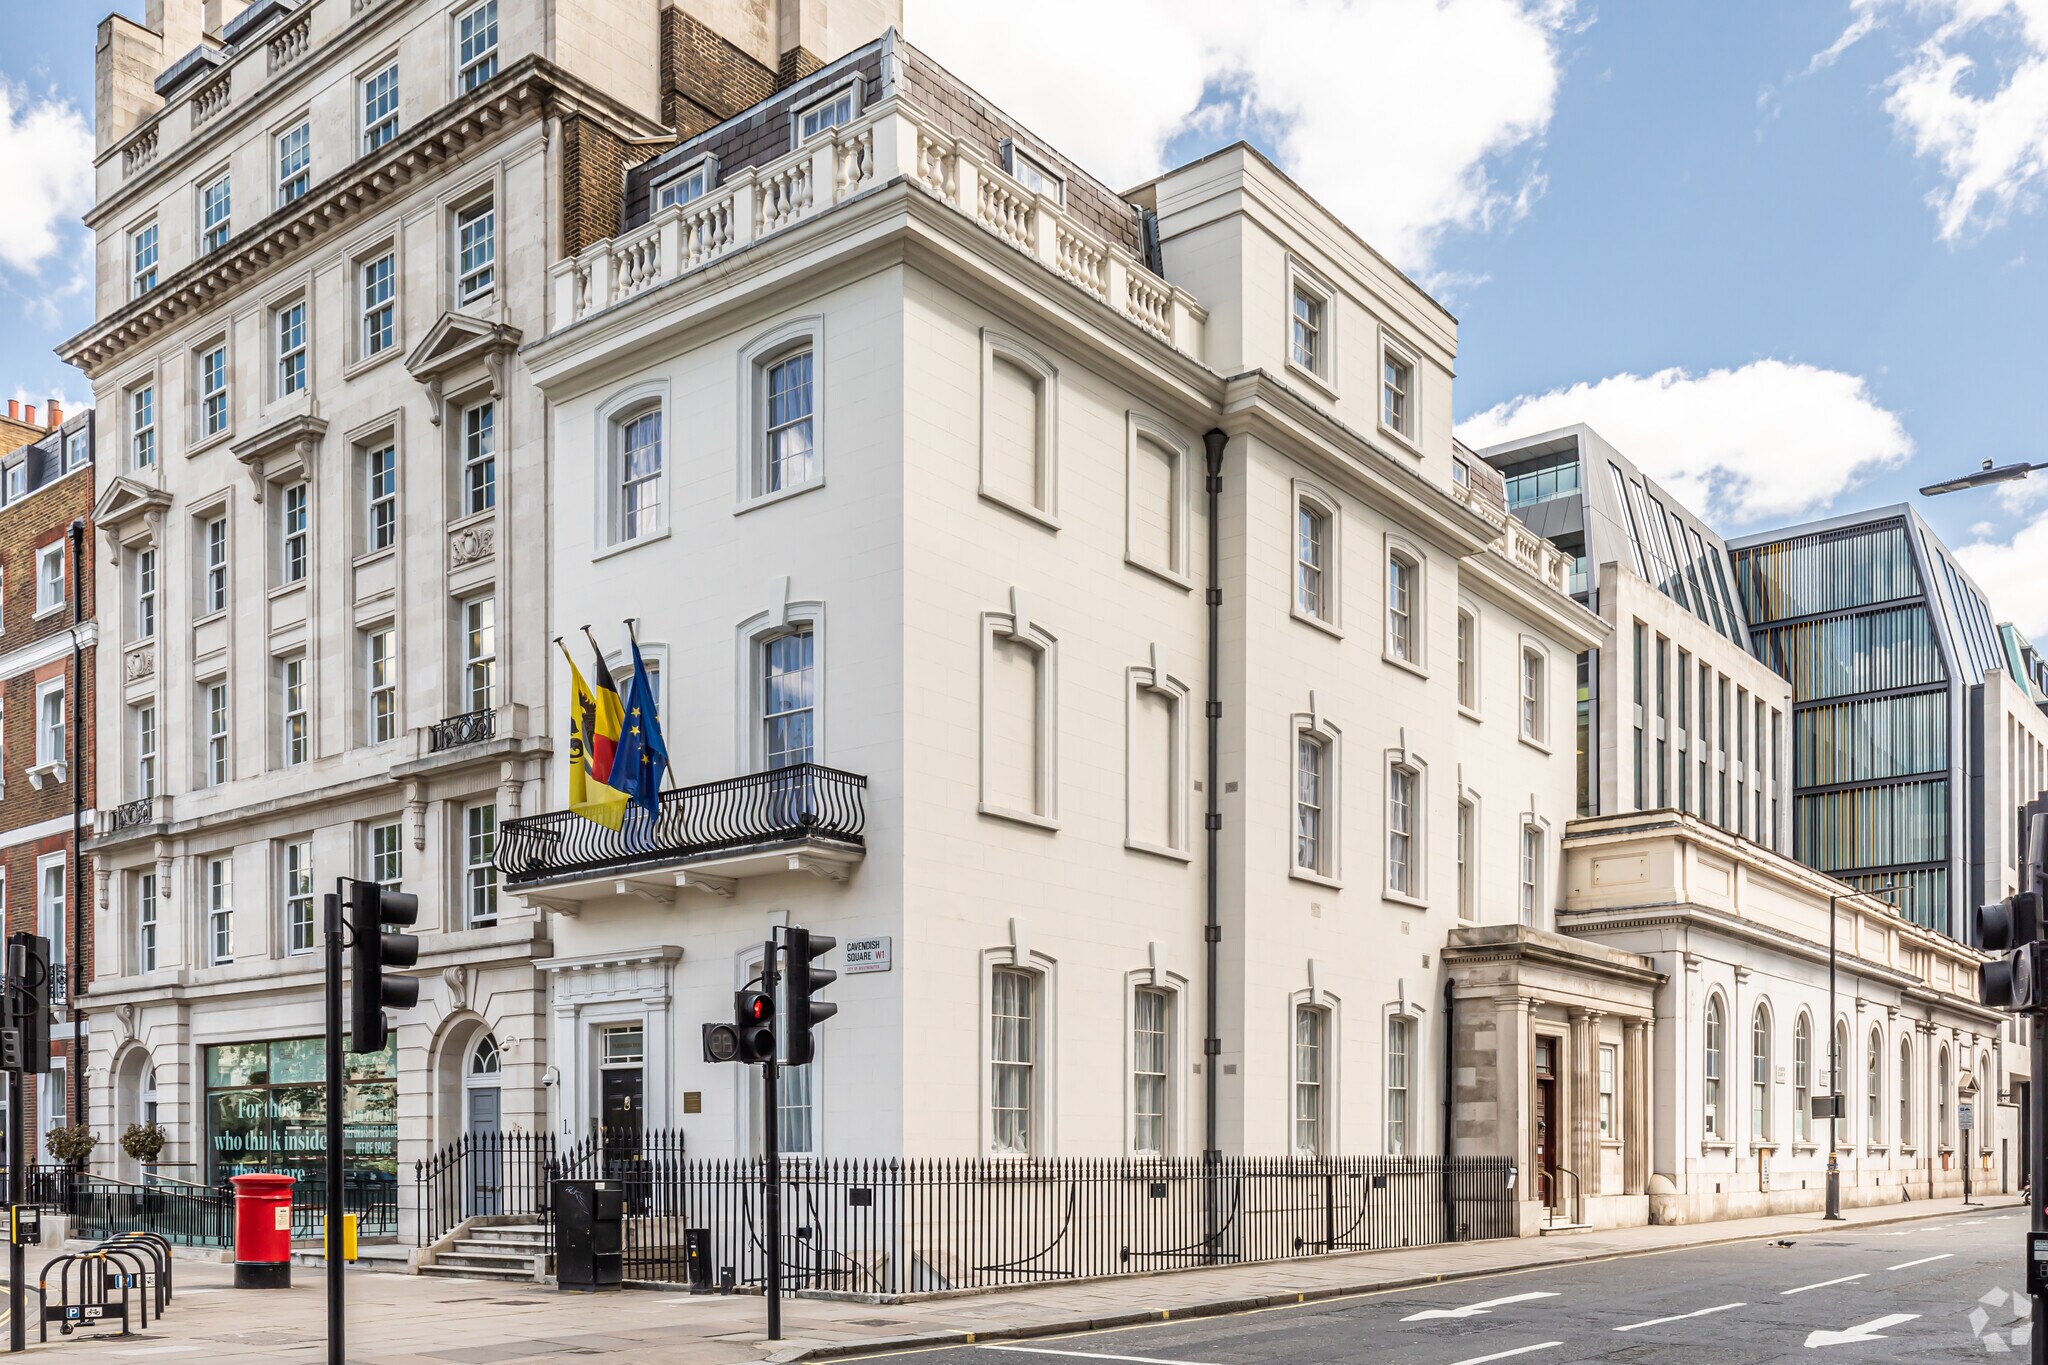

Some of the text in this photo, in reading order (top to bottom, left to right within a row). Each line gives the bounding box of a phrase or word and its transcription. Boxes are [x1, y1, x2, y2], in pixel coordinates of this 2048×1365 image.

[847, 941, 880, 951] CAVENDISH
[847, 951, 885, 962] SQUARE W1
[238, 1098, 302, 1119] For those
[345, 1125, 397, 1139] REFURBISHED GRADE
[214, 1129, 327, 1151] who think inside
[356, 1141, 392, 1155] OFFICE SPACE
[258, 1167, 306, 1182] uare
[70, 1308, 78, 1317] P
